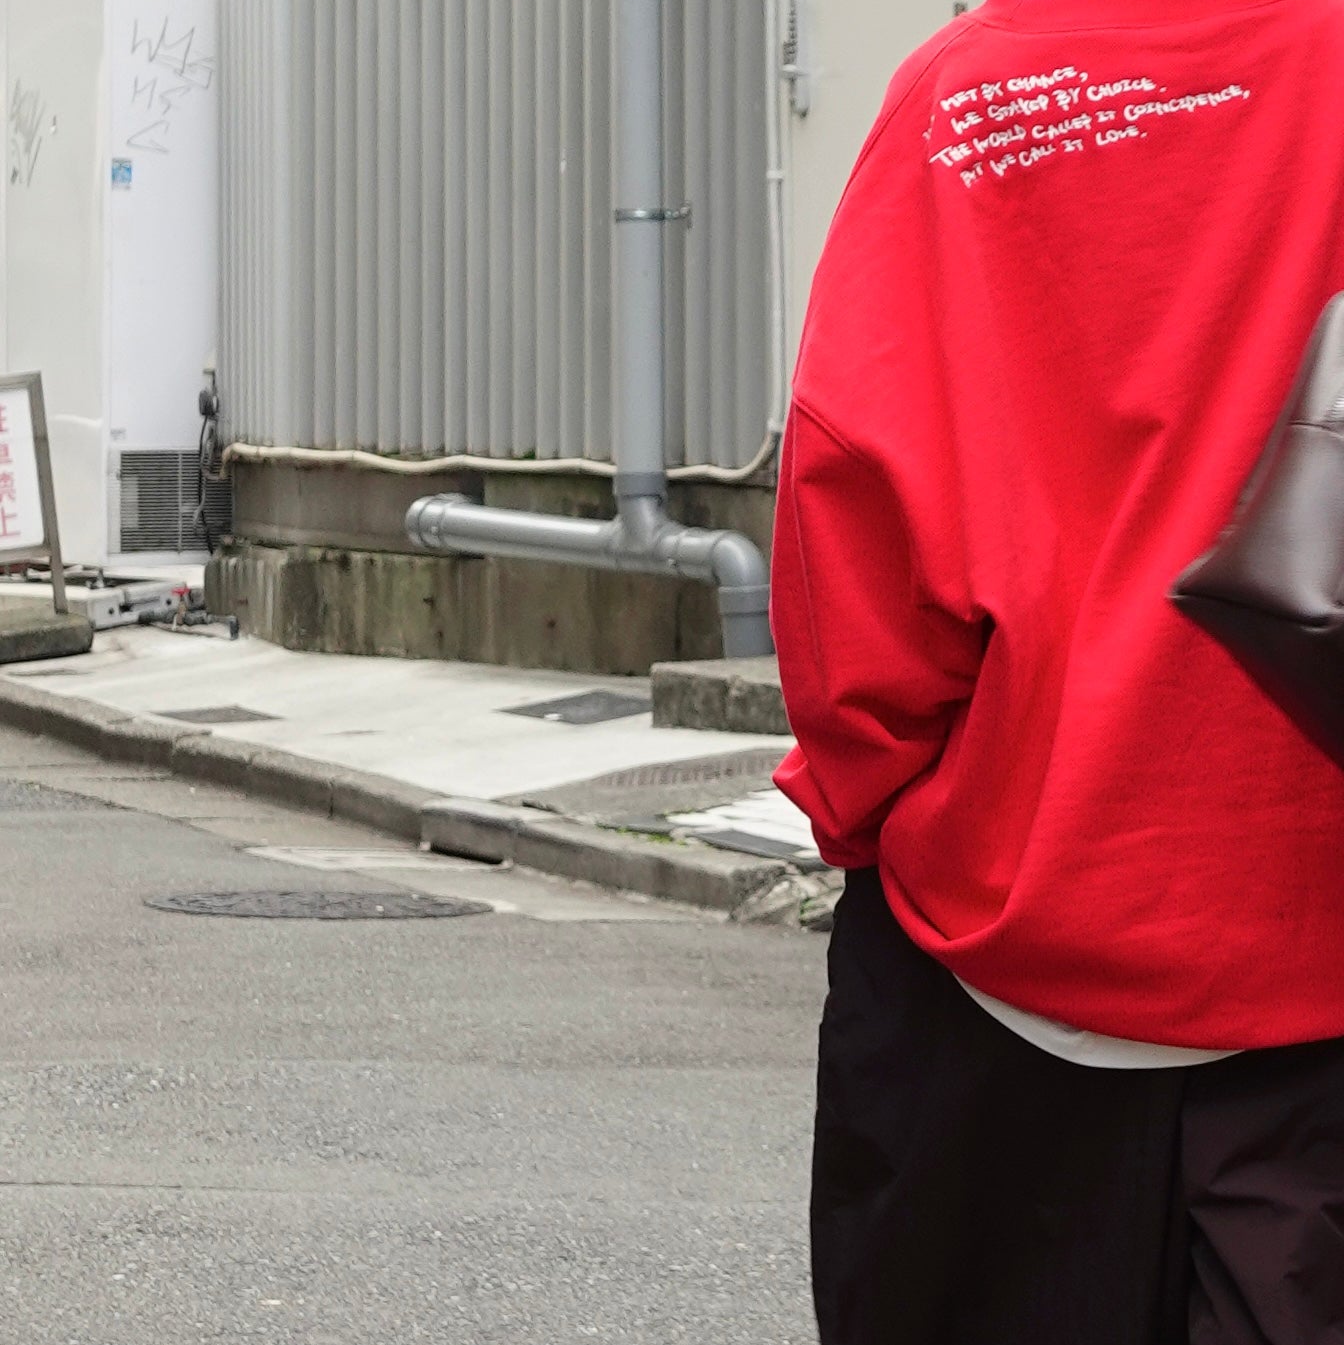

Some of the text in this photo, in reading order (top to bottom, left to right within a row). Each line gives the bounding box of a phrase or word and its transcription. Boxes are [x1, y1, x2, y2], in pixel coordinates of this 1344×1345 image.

[940, 88, 977, 111] MET
[950, 111, 983, 135] WE
[1052, 87, 1080, 111] BY
[929, 142, 973, 167] THE
[972, 124, 1027, 147] WORLD
[1095, 110, 1116, 122] IT
[1018, 143, 1056, 167] CALL
[1061, 138, 1084, 152] IT
